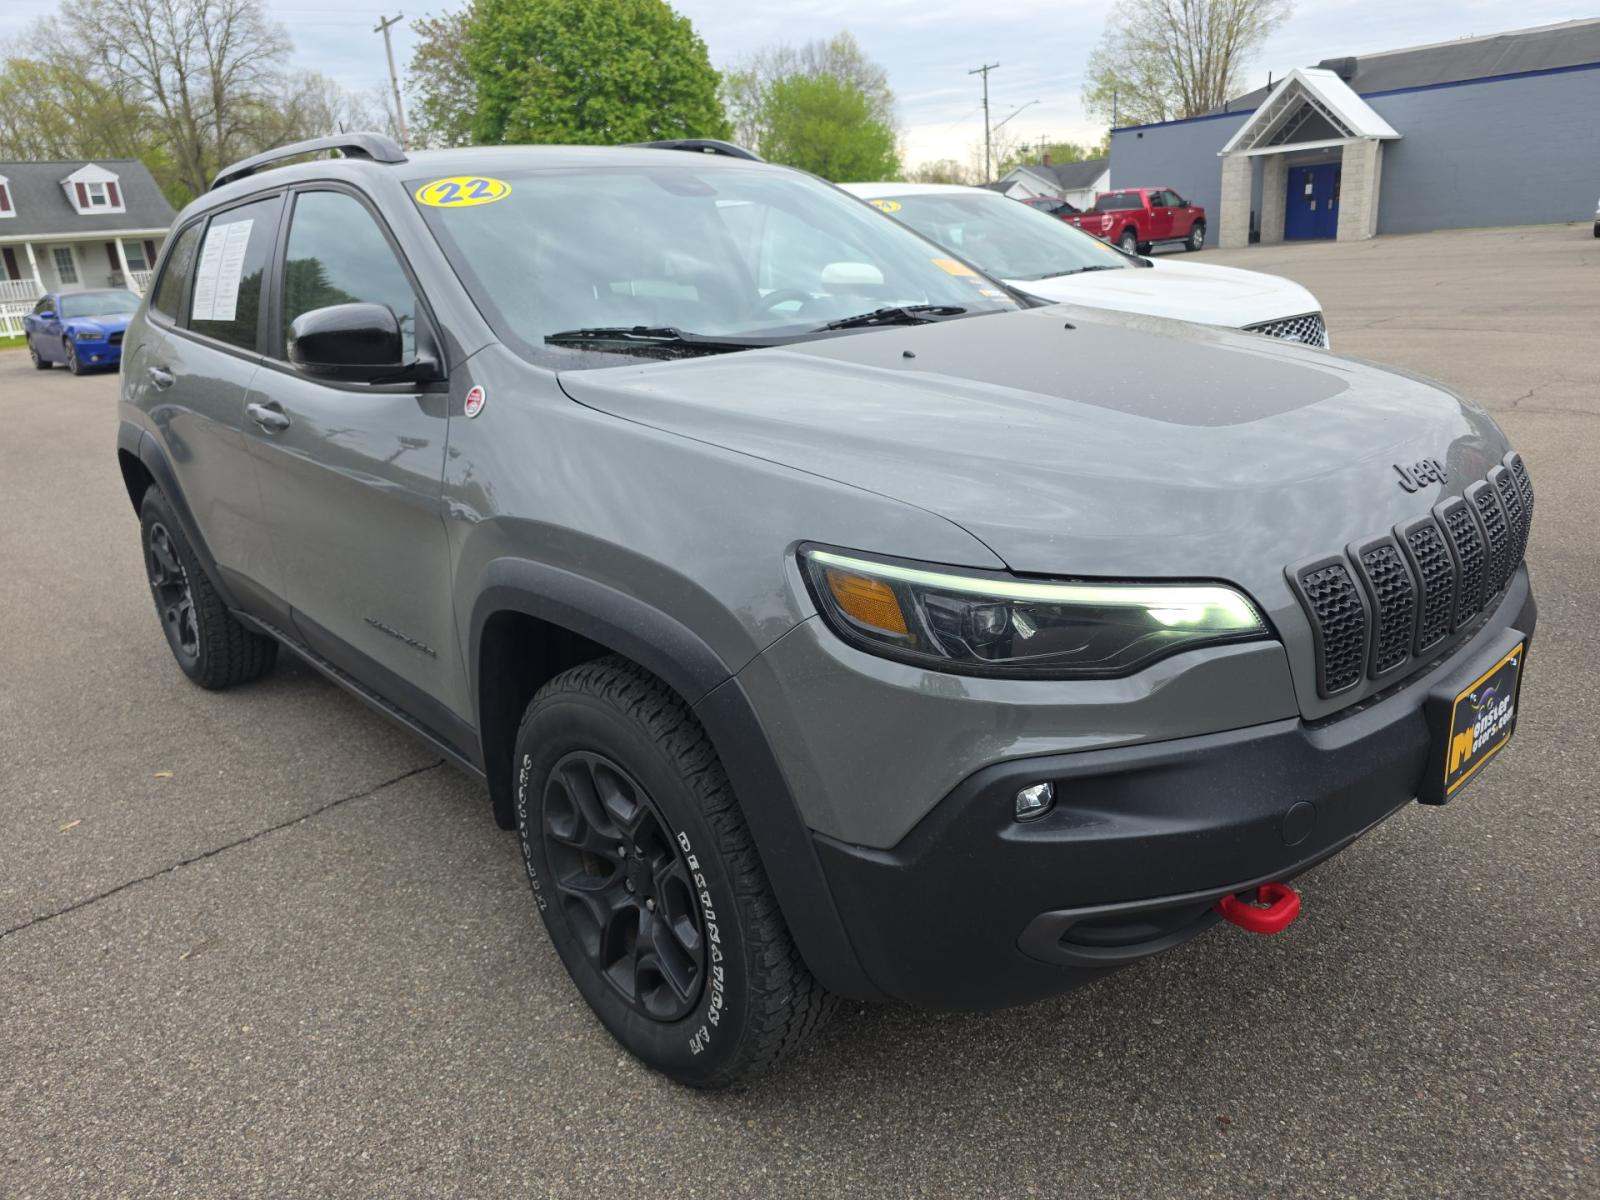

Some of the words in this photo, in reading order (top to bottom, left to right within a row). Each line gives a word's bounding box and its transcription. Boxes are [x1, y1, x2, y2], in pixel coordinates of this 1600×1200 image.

[435, 178, 494, 204] 22
[1392, 457, 1448, 493] Jeep
[677, 831, 724, 1027] DESTINATION
